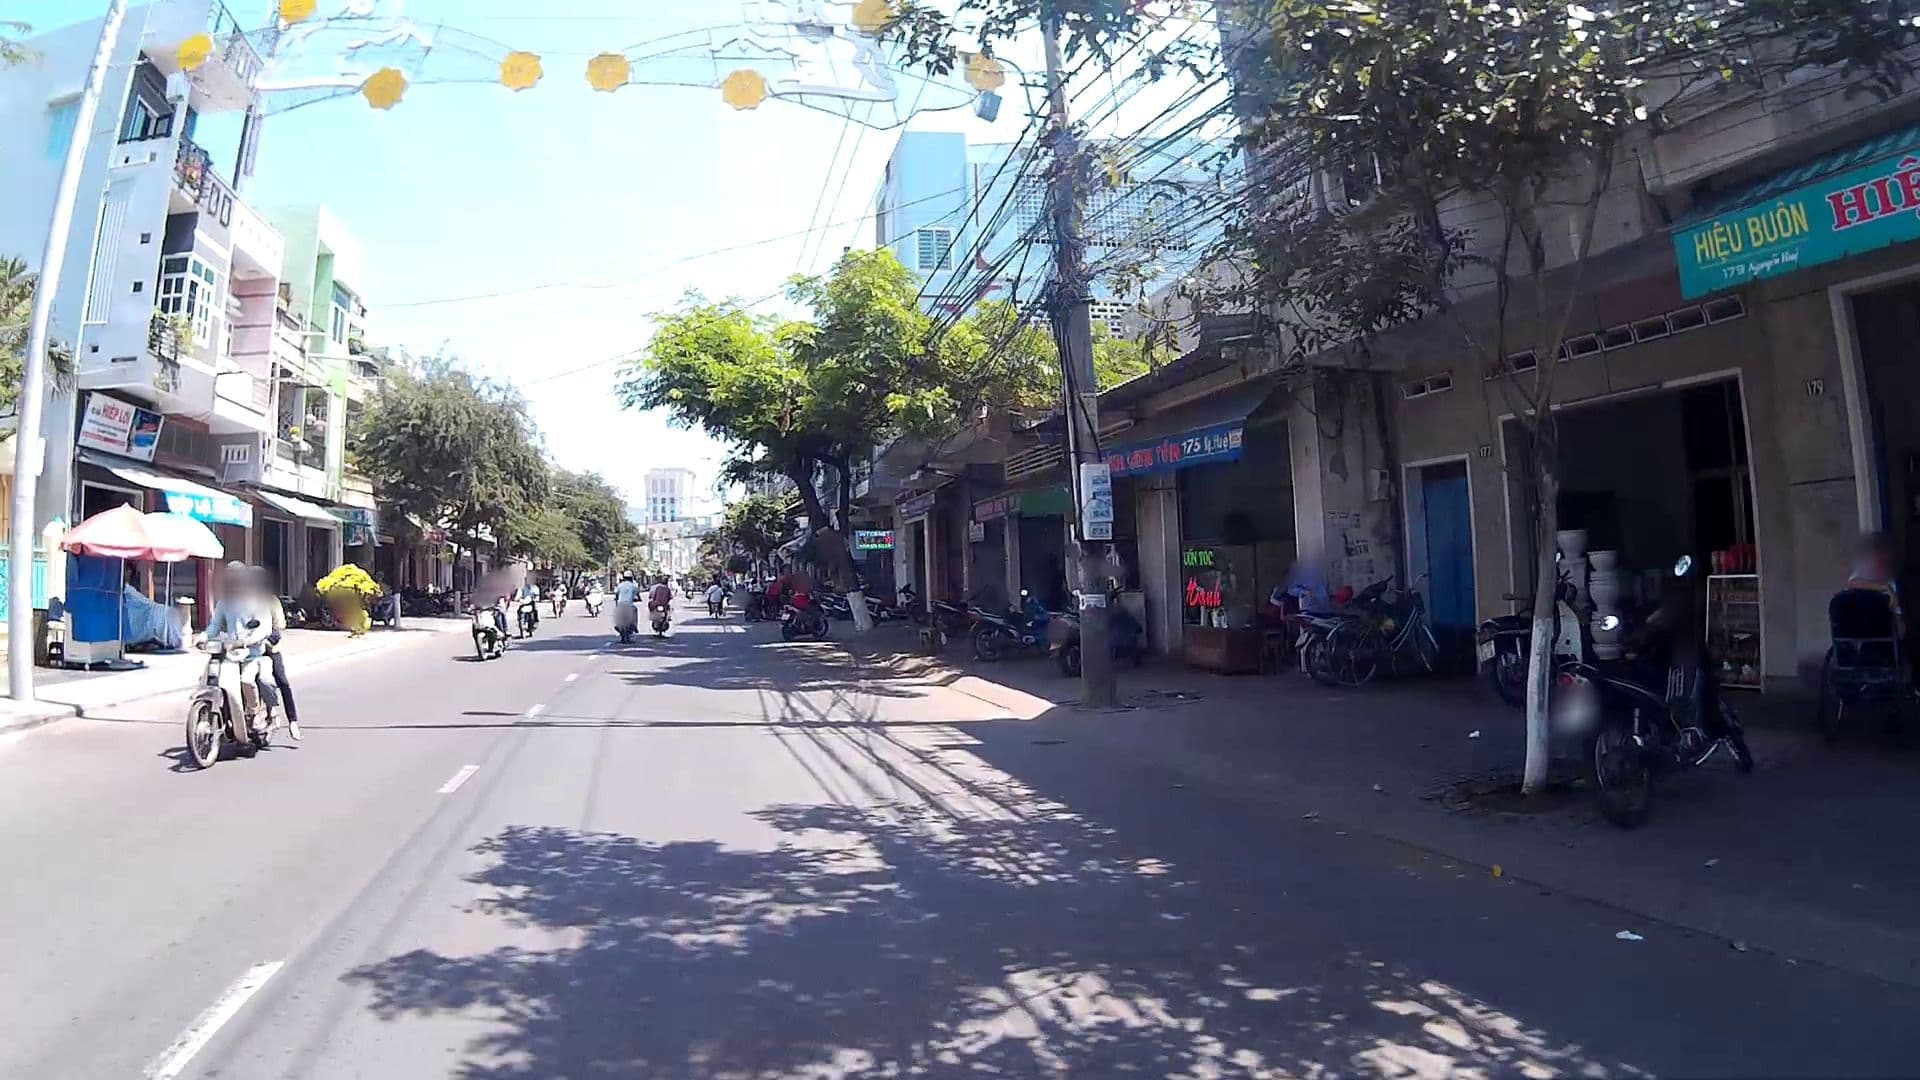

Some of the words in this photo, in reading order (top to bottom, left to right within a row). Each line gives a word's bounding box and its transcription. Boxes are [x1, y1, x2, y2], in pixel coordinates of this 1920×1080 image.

[1693, 221, 1742, 264] HIỆU
[1747, 201, 1809, 247] BUÔN
[1722, 264, 1745, 279] 179
[1806, 379, 1824, 397] 179
[1181, 437, 1200, 455] 175
